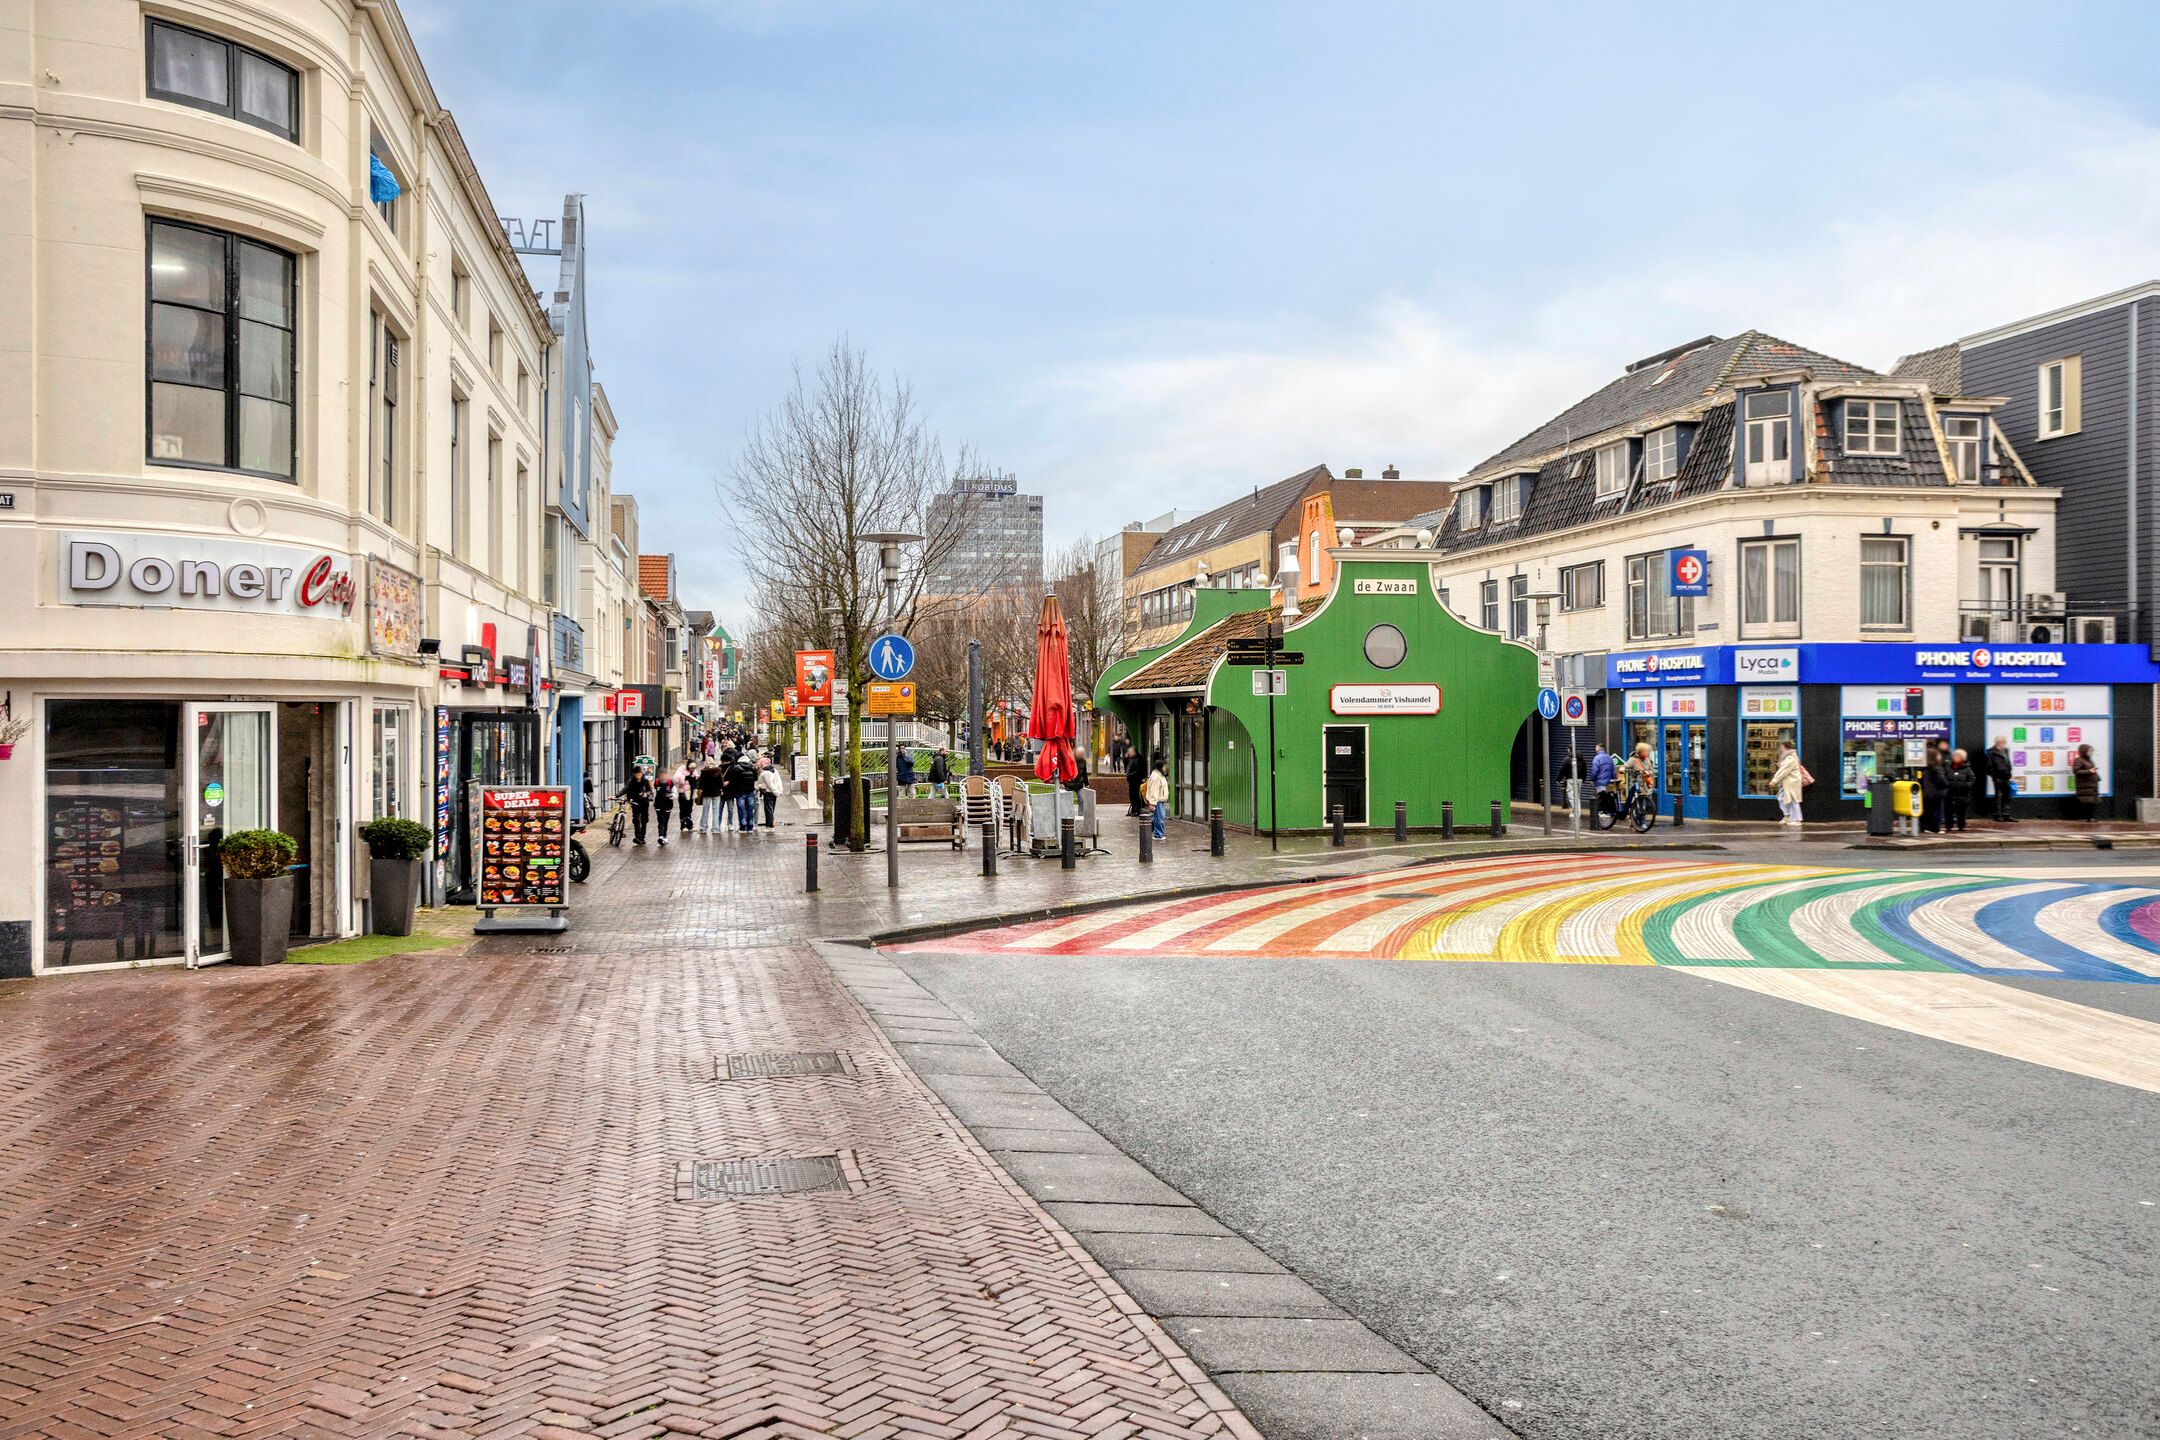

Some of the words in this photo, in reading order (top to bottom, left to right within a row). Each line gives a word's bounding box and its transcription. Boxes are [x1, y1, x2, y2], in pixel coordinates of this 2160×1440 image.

[70, 541, 292, 600] Doner
[301, 556, 355, 616] City
[1357, 581, 1371, 592] de
[1376, 581, 1415, 592] Zwaan
[1616, 659, 1647, 672] PHONE
[1659, 655, 1705, 670] HOSPITAL
[1740, 656, 1779, 671] Lyca
[1916, 651, 1970, 666] PHONE
[1993, 651, 2066, 666] HOSPITAL
[705, 660, 714, 700] HEMA
[1845, 721, 1881, 731] PHONE
[494, 792, 529, 800] SUPER
[504, 799, 540, 808] DEALS
